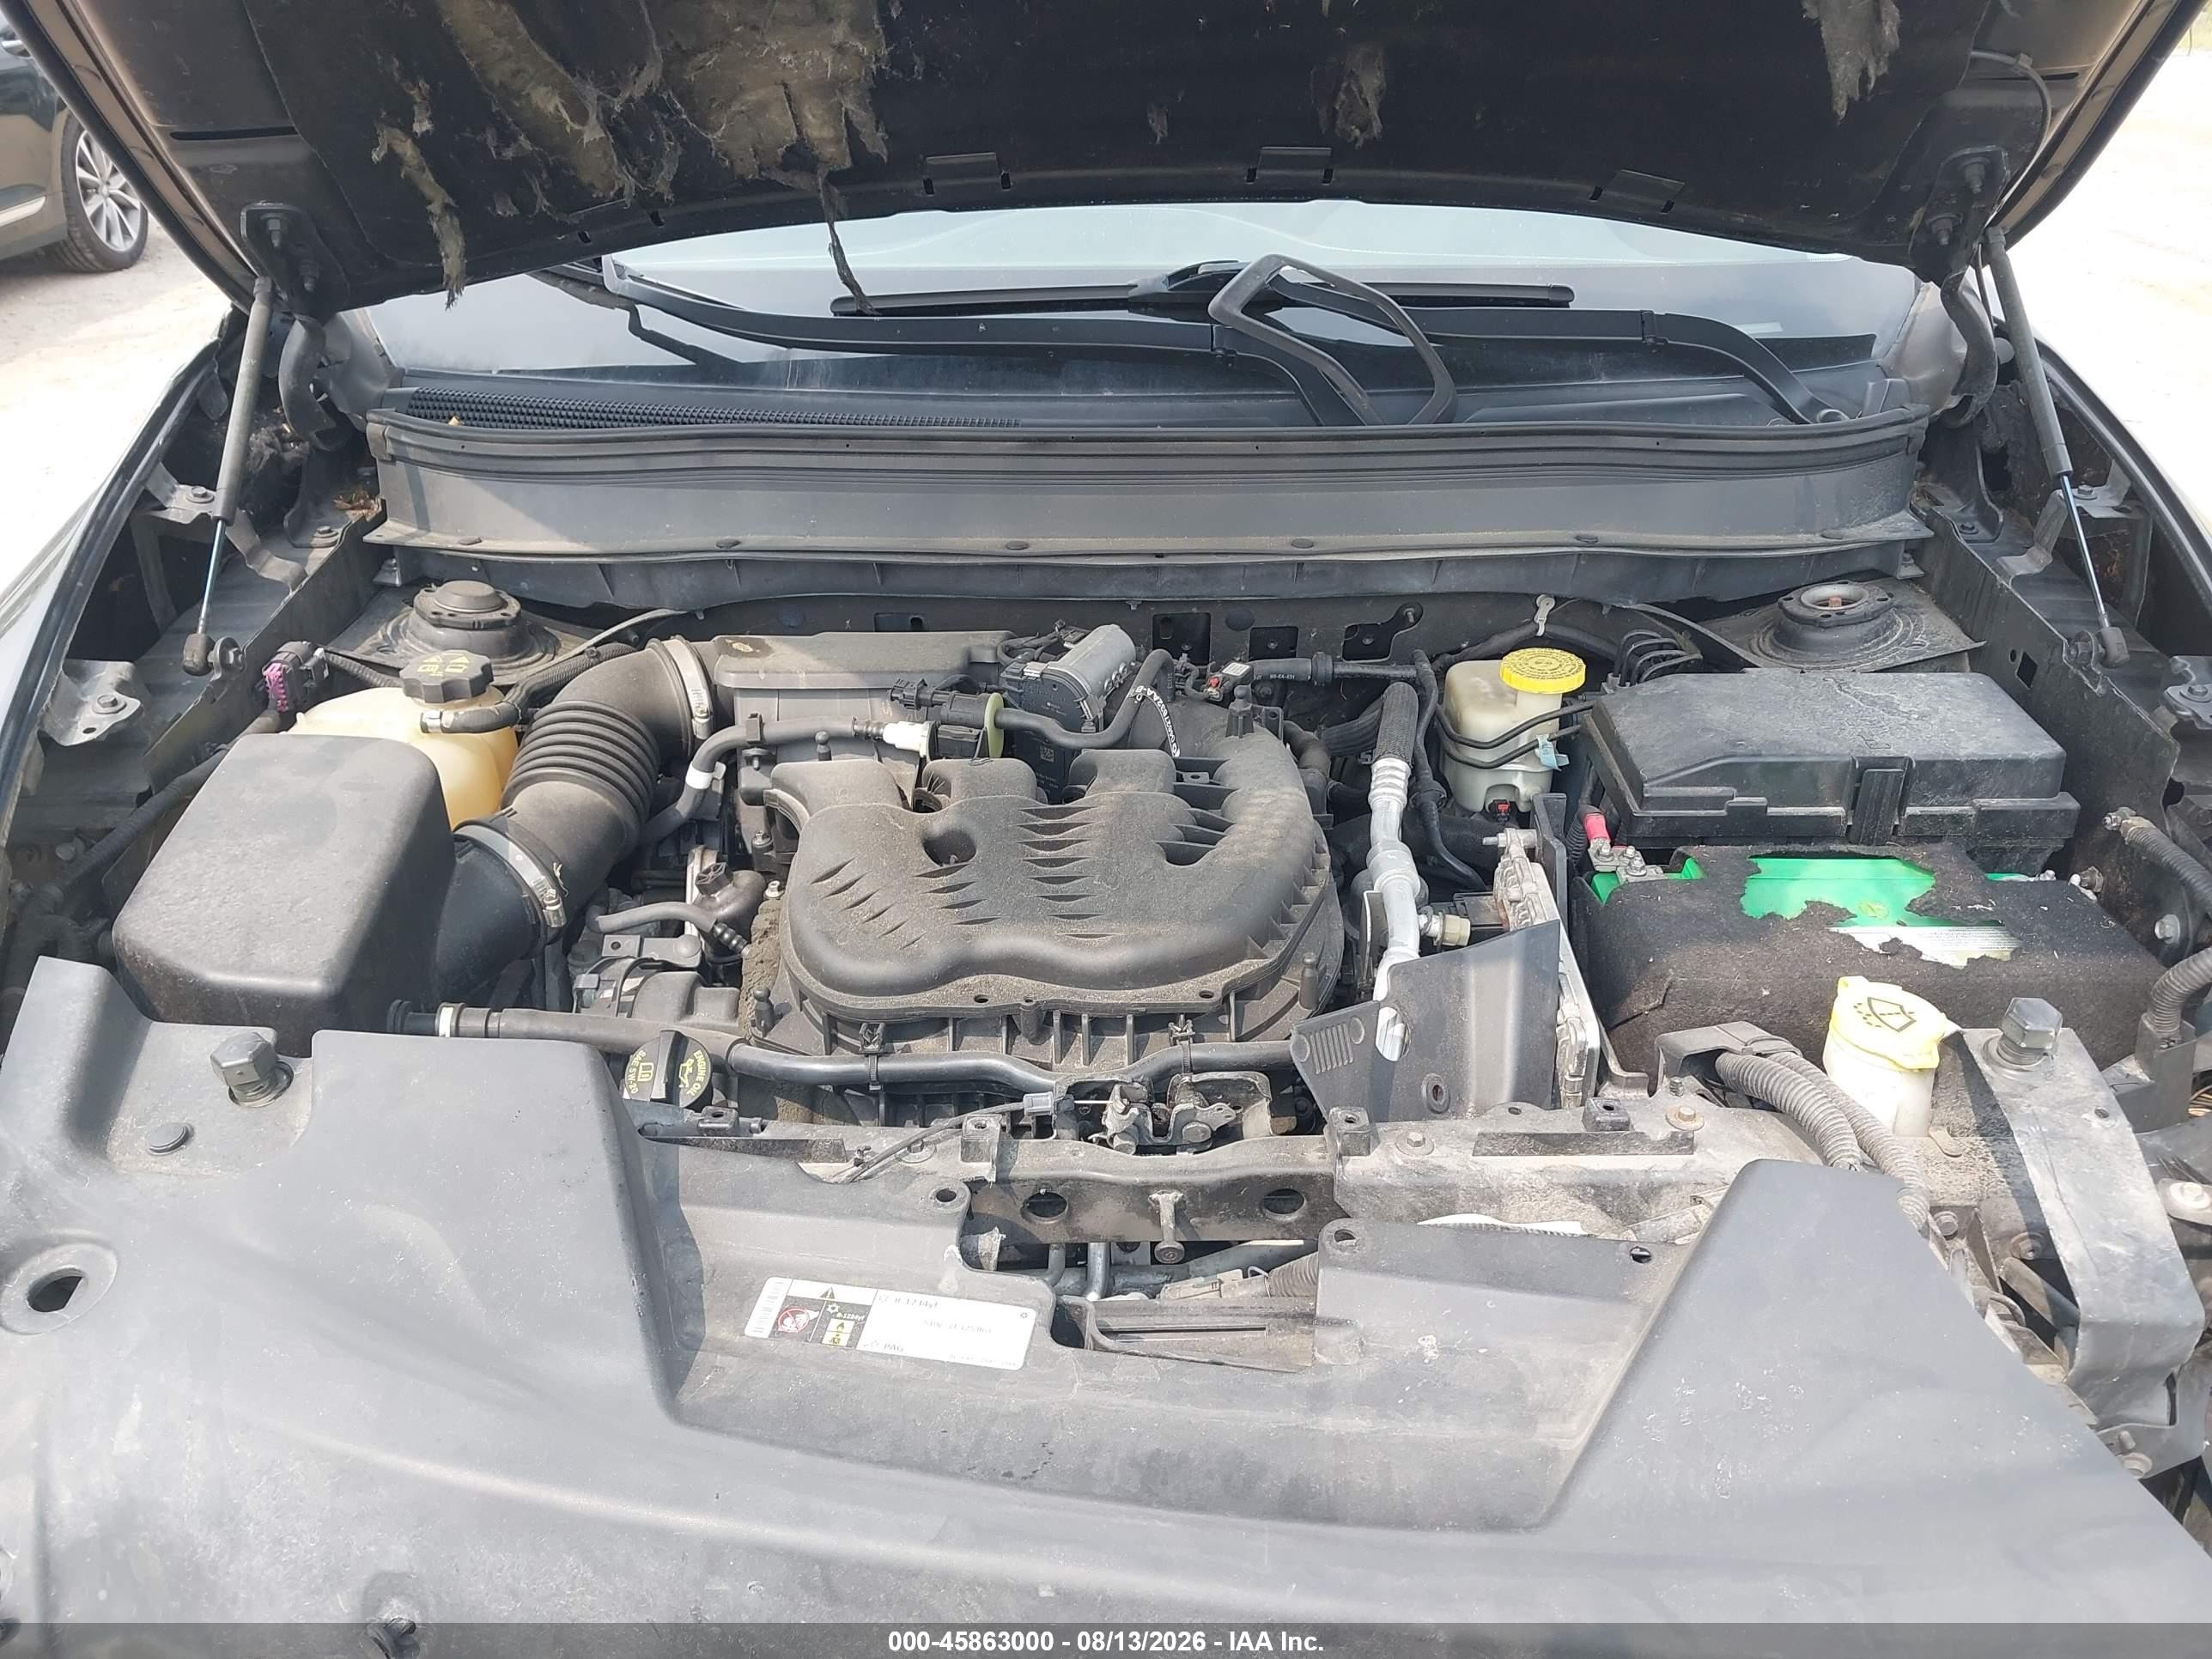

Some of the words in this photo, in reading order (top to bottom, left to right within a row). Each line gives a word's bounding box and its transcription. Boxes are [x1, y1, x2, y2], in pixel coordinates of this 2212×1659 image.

[632, 1050, 646, 1066] SAE
[694, 1049, 707, 1082] ENGINE
[628, 1067, 639, 1094] 5W-20
[686, 1082, 702, 1097] OIL
